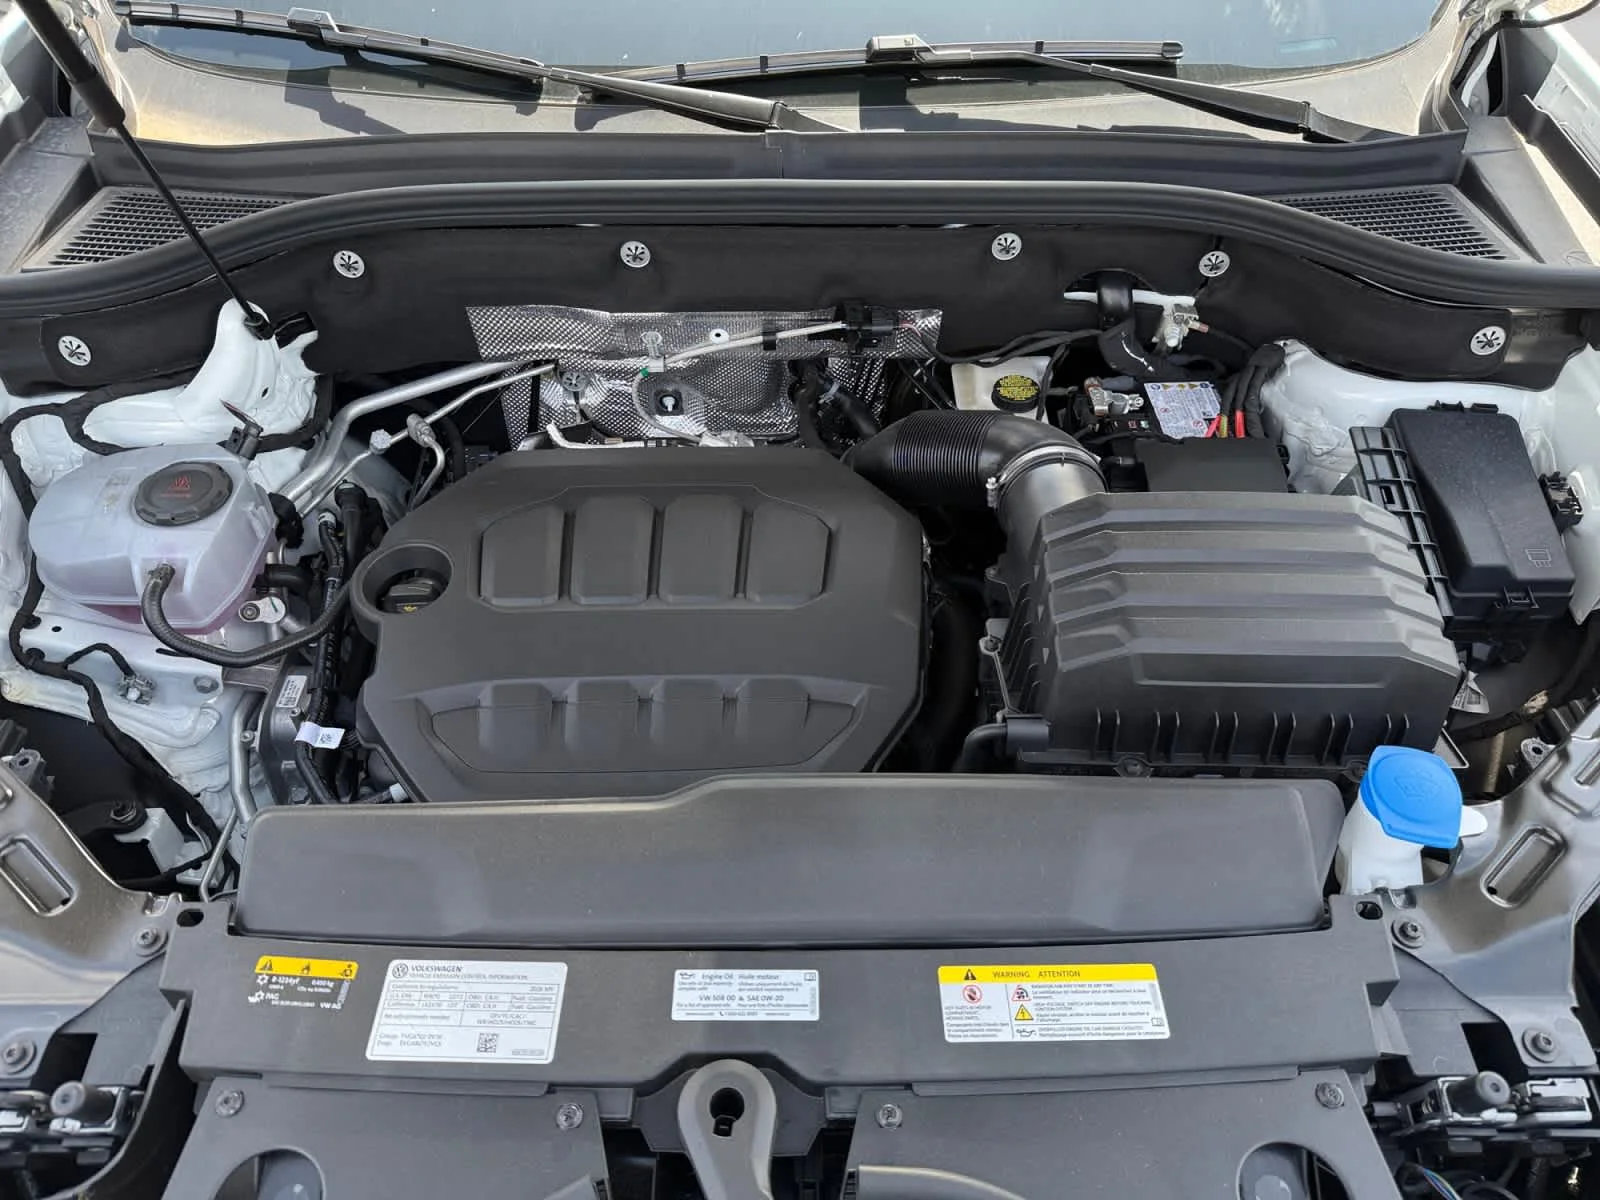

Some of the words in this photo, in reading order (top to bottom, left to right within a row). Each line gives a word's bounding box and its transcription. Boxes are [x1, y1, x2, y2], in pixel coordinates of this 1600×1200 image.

[410, 965, 463, 973] VOLKSWAGEN
[701, 972, 723, 981] Engine
[724, 972, 734, 980] Oil
[992, 970, 1030, 979] WARNING
[1038, 970, 1081, 978] ATTENTION
